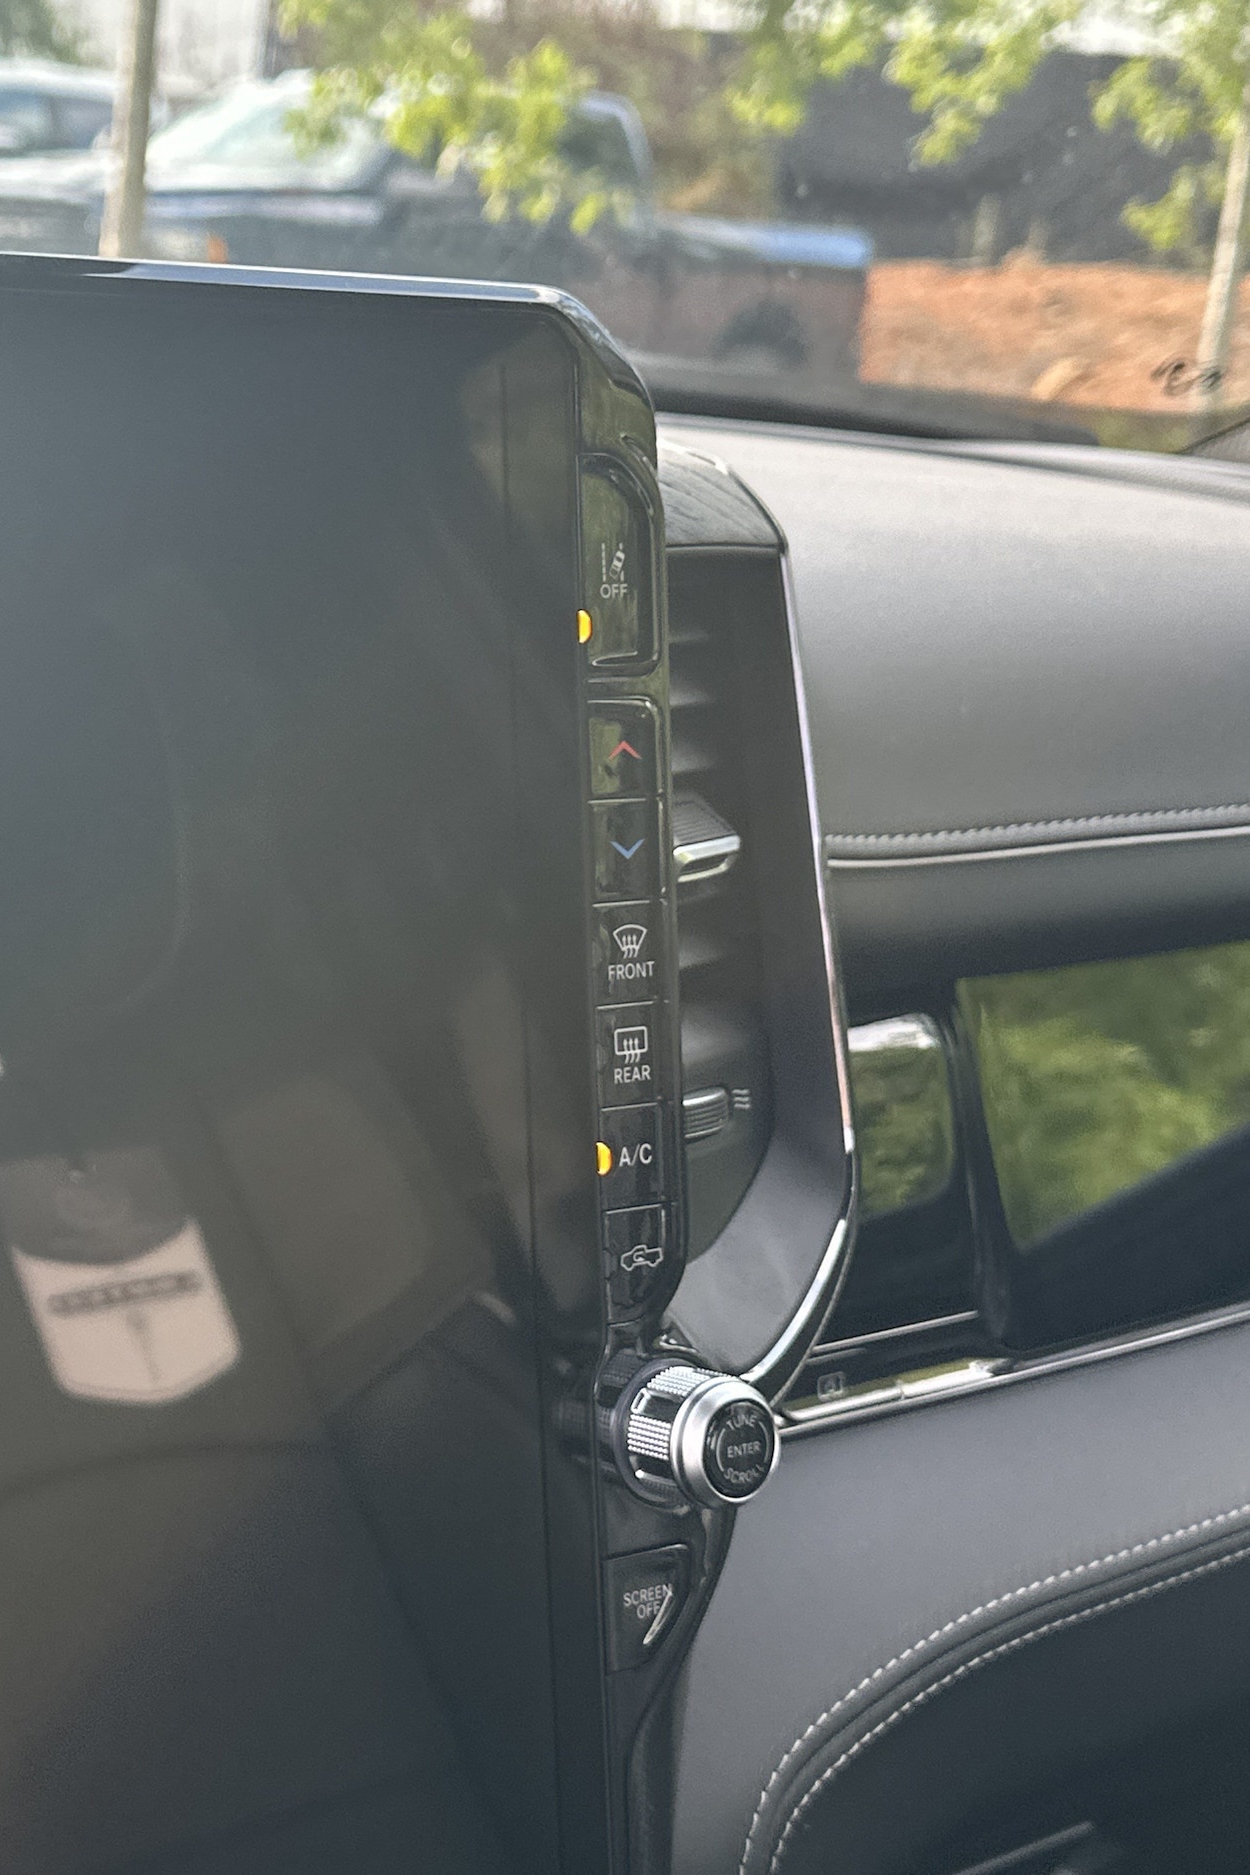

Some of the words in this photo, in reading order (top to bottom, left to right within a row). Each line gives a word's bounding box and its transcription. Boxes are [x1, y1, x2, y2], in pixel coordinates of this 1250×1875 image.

[600, 584, 628, 599] OFF
[607, 961, 655, 981] FRONT
[613, 1064, 651, 1084] REAR
[619, 1143, 652, 1167] A/C
[726, 1414, 758, 1431] TUNE
[727, 1441, 761, 1458] ENTER
[723, 1463, 765, 1483] SCROLL
[623, 1583, 673, 1607] SCREEN
[636, 1600, 661, 1619] OFF
